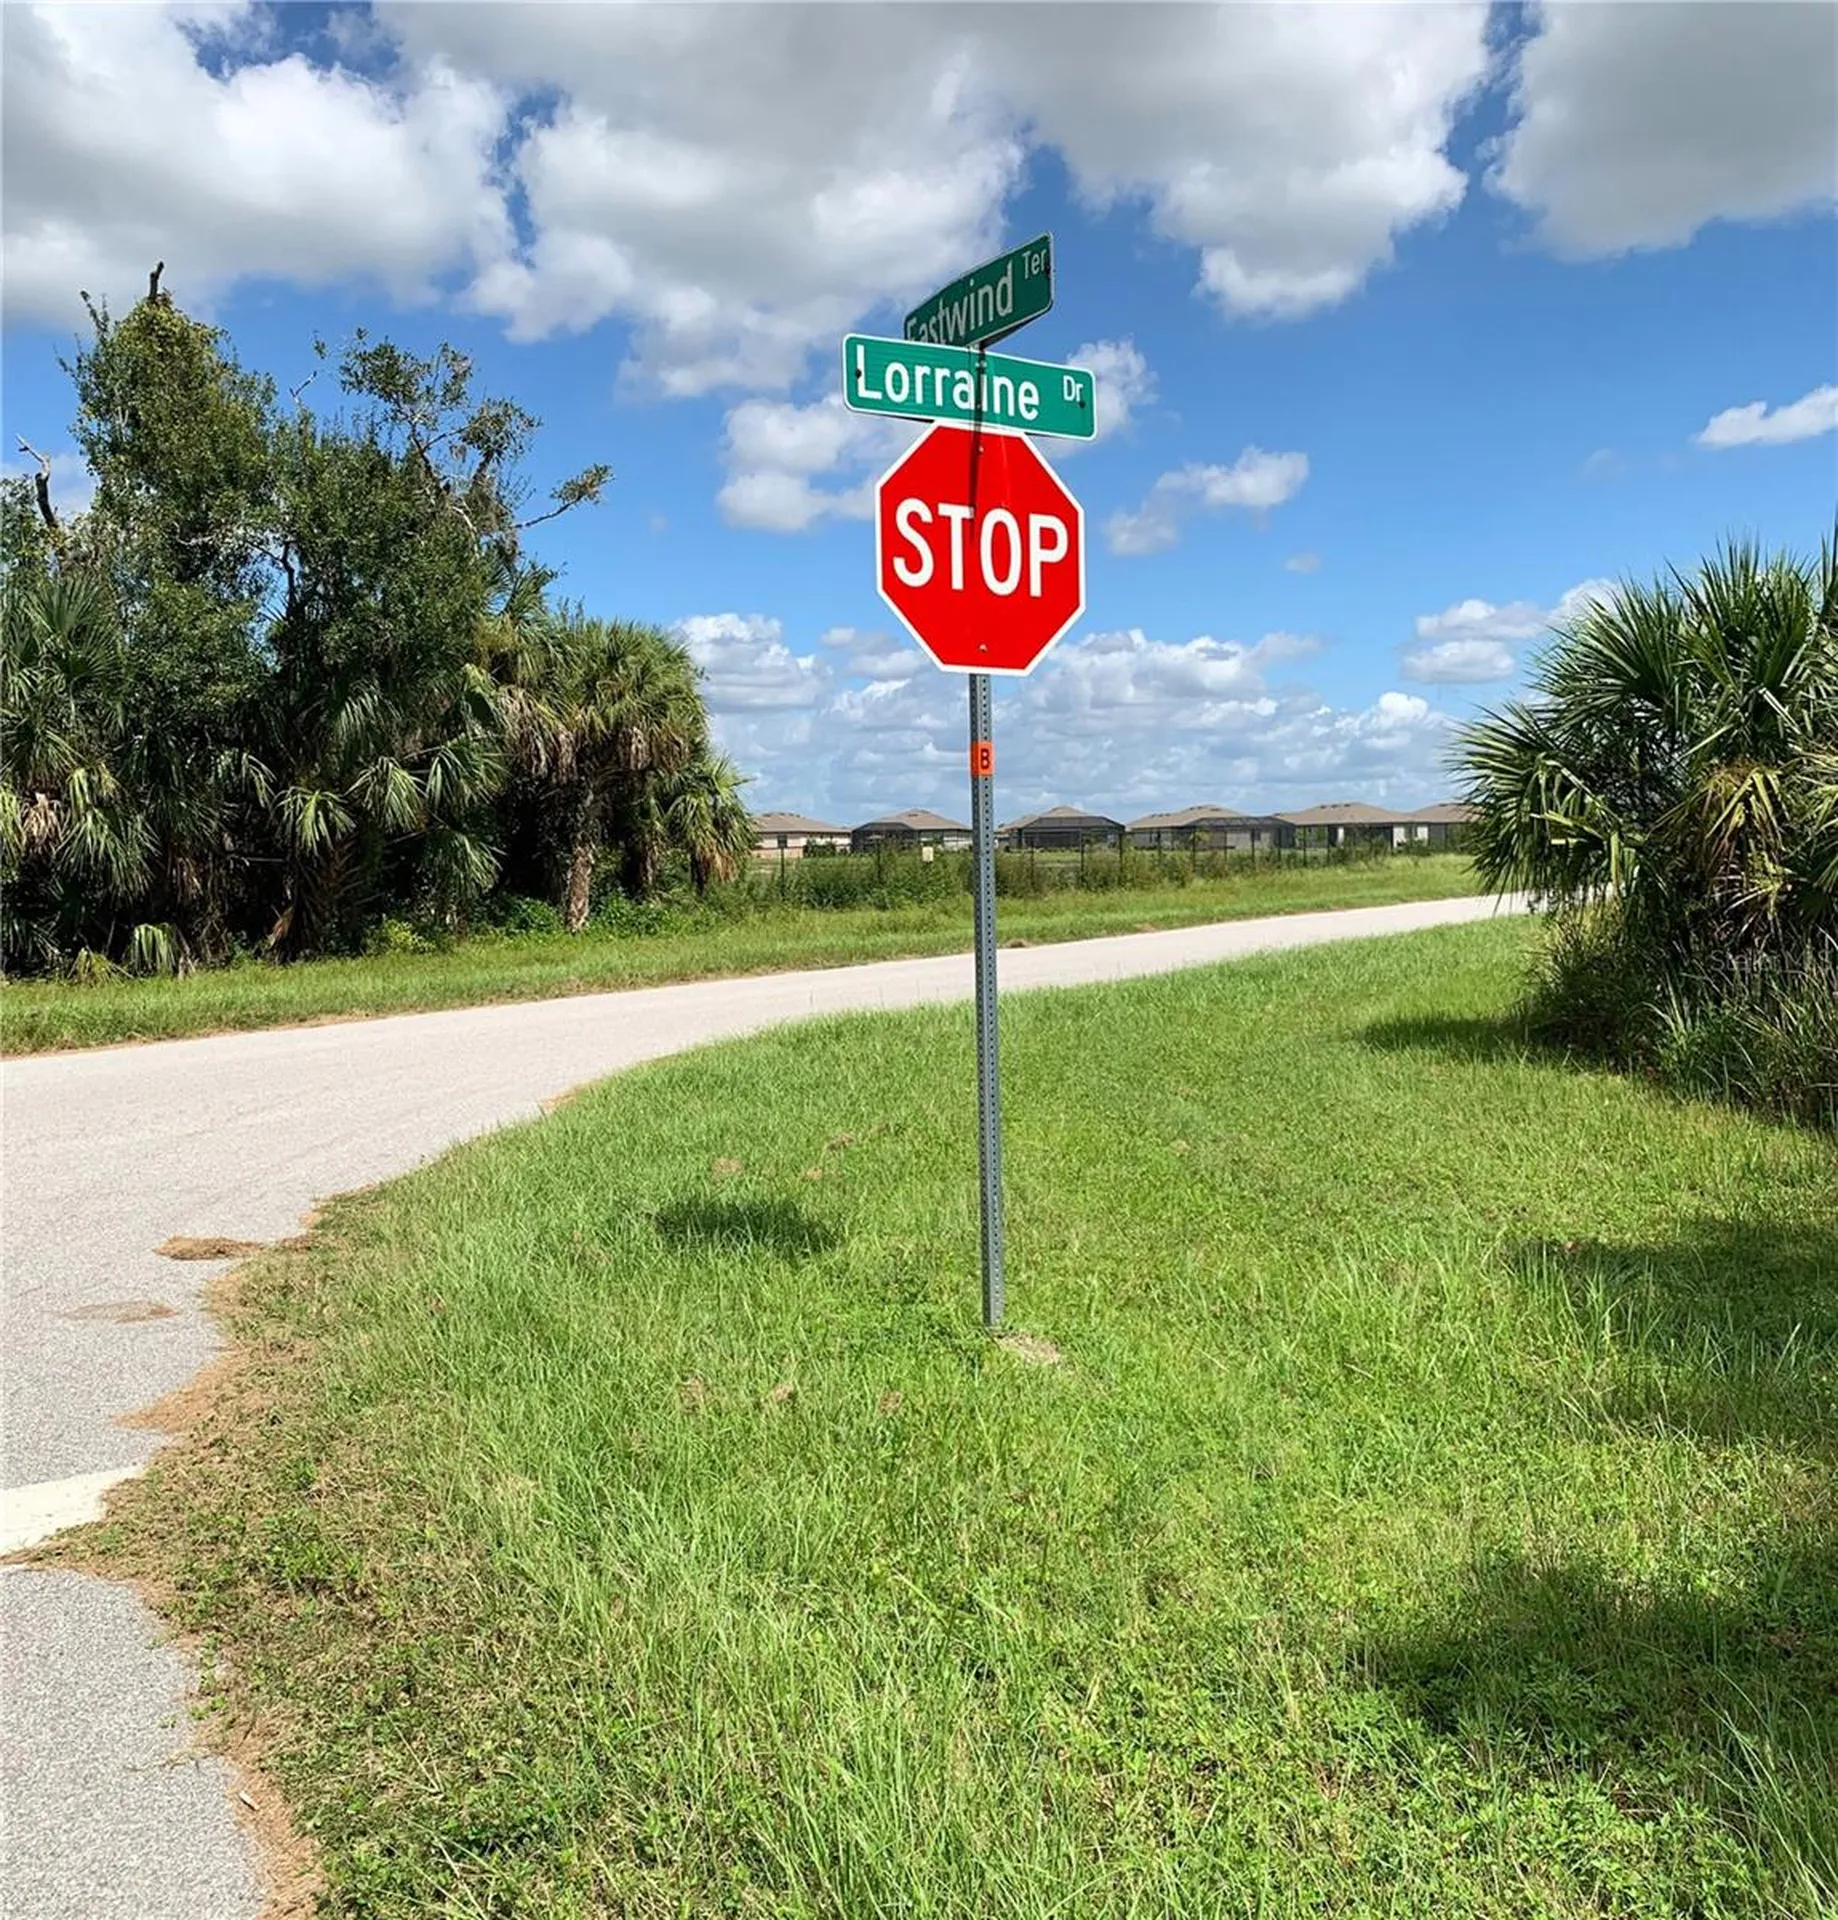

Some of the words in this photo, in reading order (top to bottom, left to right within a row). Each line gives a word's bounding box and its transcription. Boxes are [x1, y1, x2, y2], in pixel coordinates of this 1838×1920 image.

[1022, 248, 1047, 280] Ter
[856, 344, 1040, 421] Lorraine
[1062, 374, 1084, 403] Dr
[892, 497, 1069, 598] STOP
[980, 748, 990, 770] B
